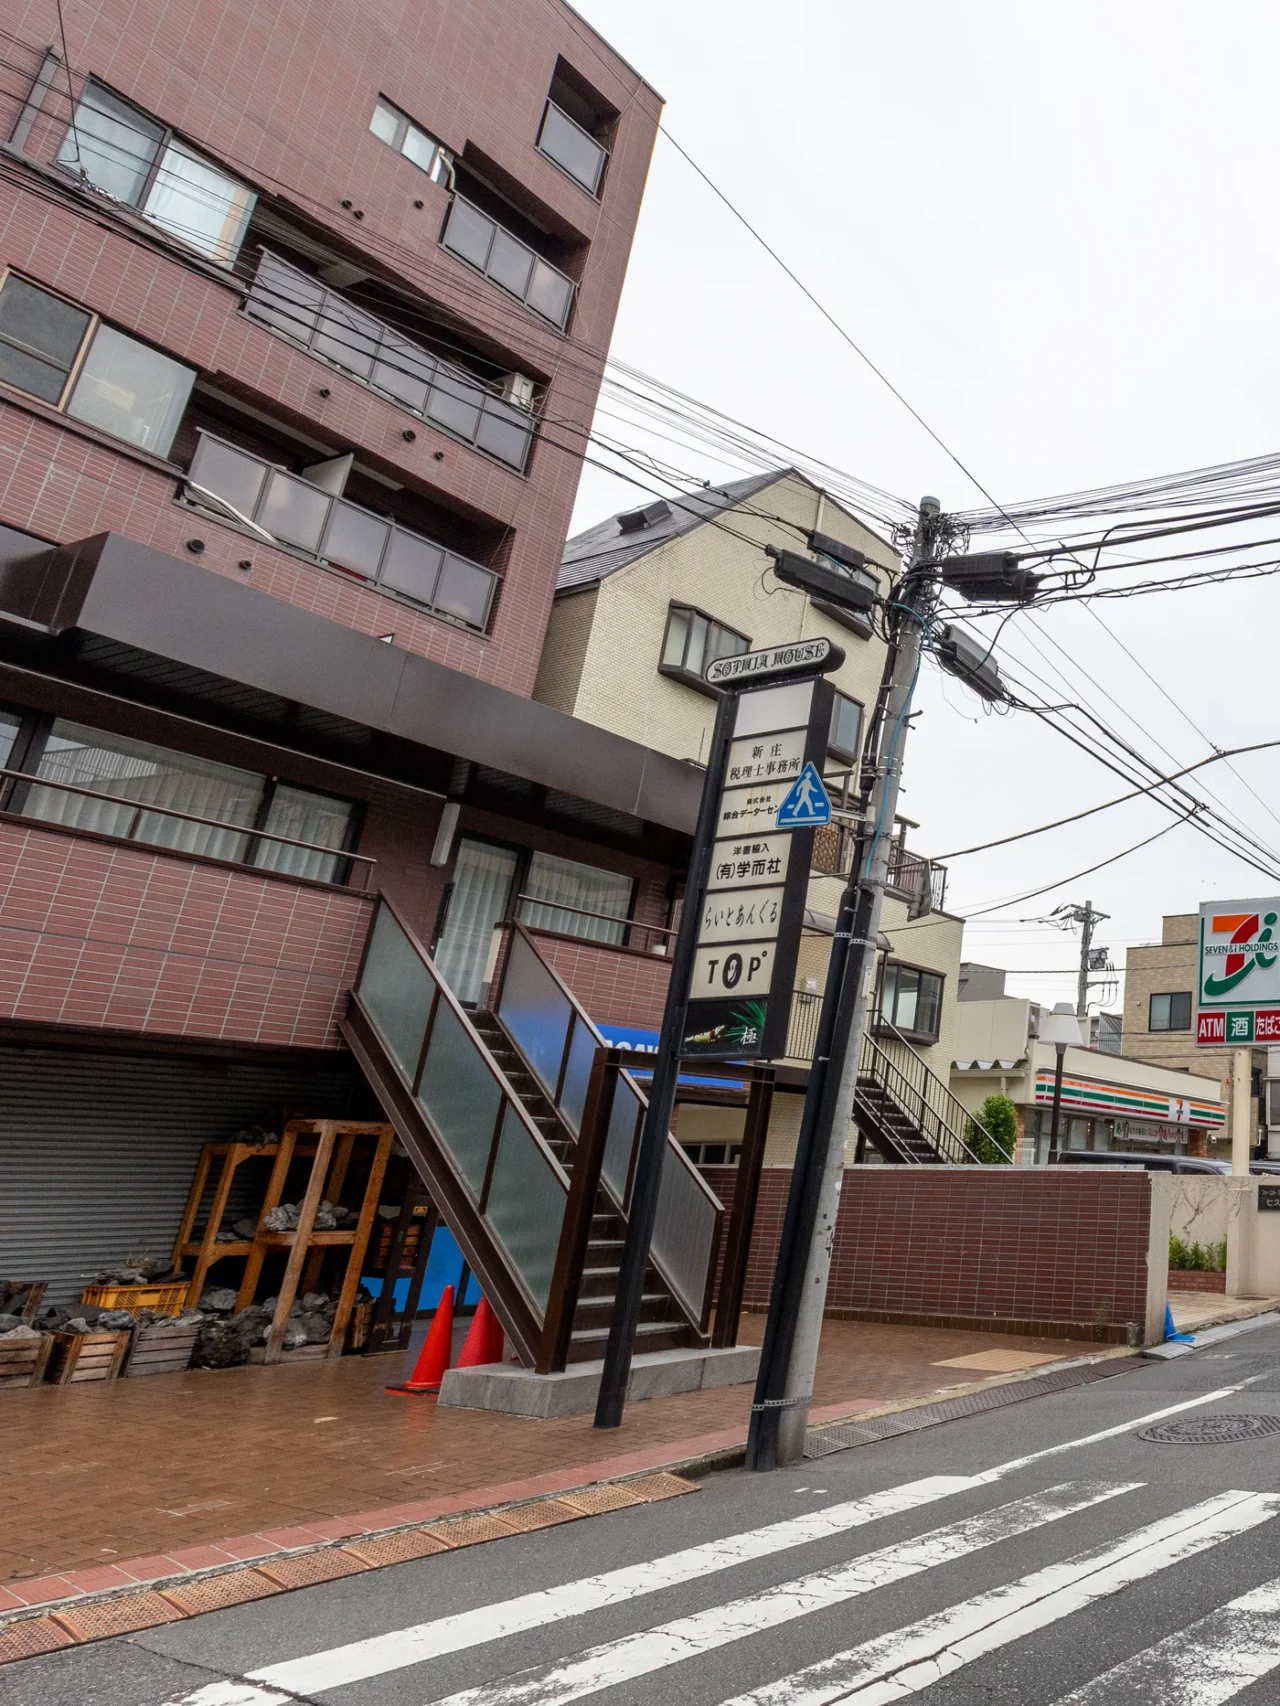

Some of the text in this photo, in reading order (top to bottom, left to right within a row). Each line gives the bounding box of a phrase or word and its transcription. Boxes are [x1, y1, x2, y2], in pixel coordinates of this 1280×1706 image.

[711, 642, 826, 680] SOPHIA HOUSE
[730, 757, 801, 781] 税理士事務所
[732, 842, 770, 857] 洋書輸入
[716, 857, 782, 880] (有)学而社
[704, 899, 778, 930] らいとあんぐる
[1238, 941, 1279, 952] HOLDINGS
[741, 1027, 758, 1045] 極
[1199, 1017, 1224, 1038] ATM
[1230, 1016, 1249, 1037] 酒
